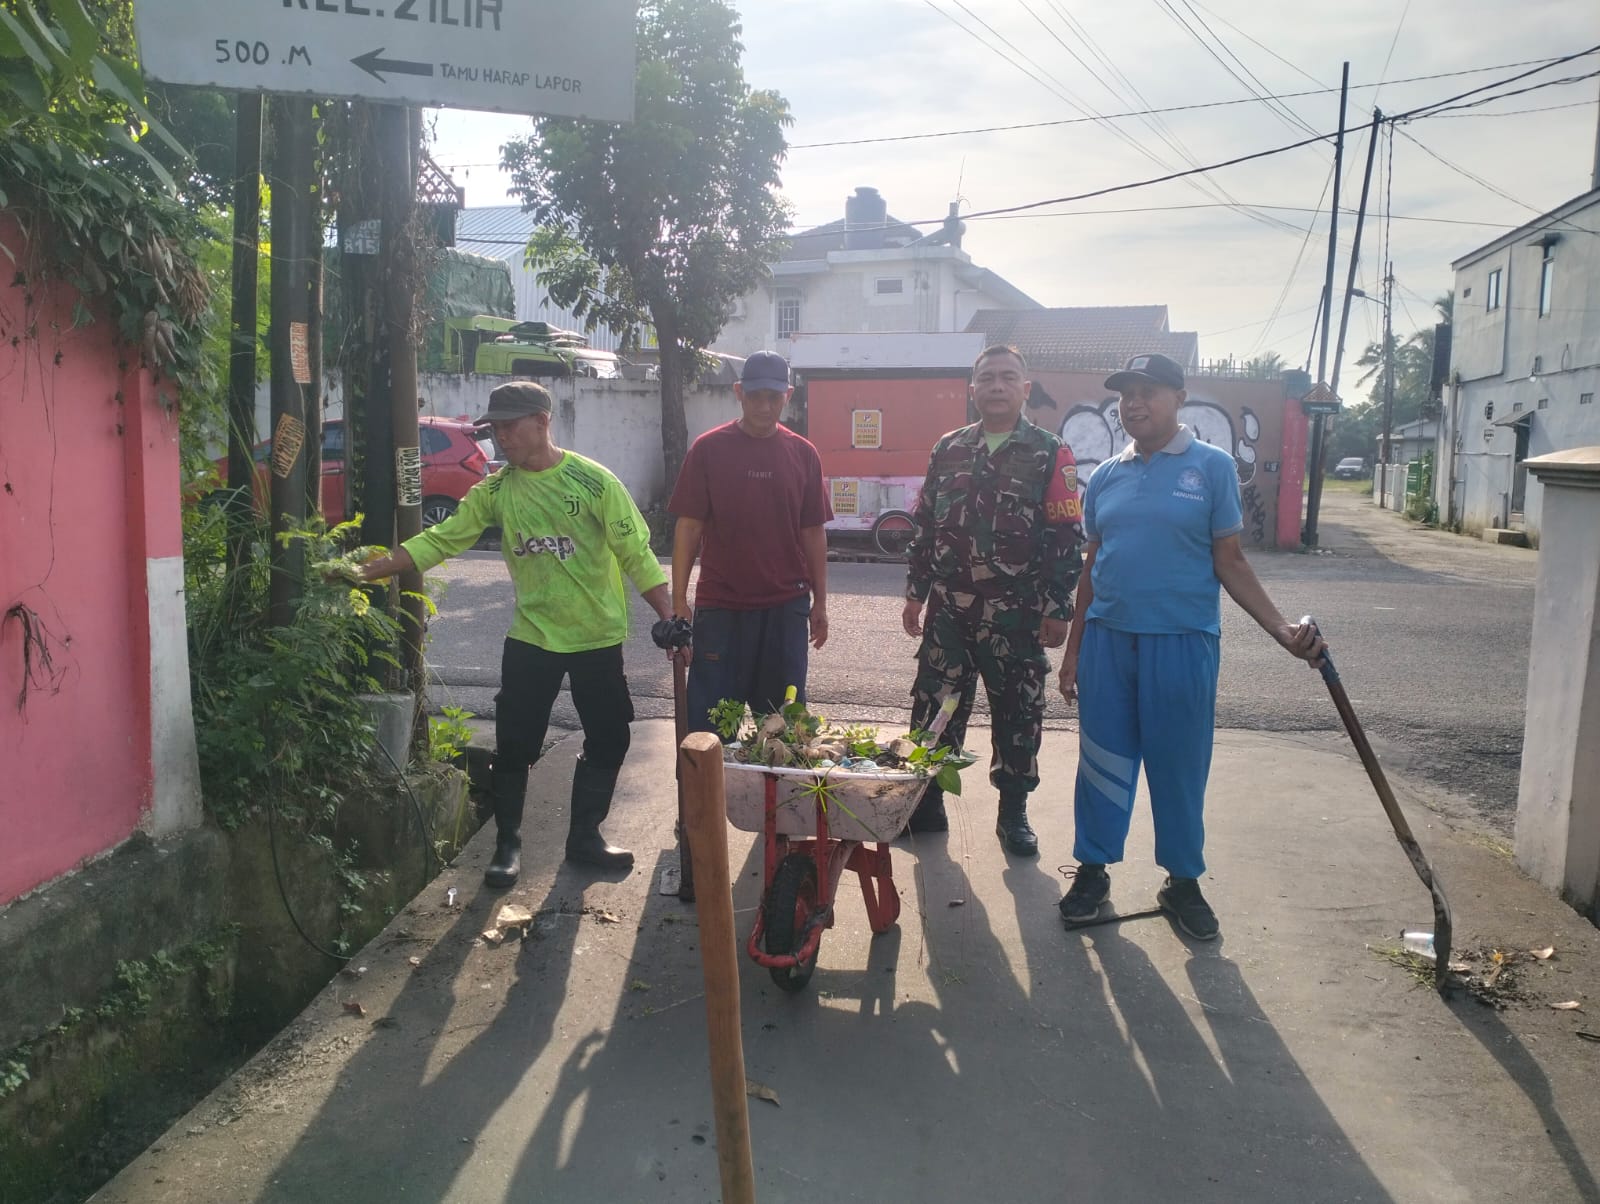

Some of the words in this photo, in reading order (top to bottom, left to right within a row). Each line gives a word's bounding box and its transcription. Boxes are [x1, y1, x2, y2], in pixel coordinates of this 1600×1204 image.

[216, 39, 270, 65] 500
[439, 62, 478, 81] TAMU
[483, 68, 530, 86] HARAP
[535, 73, 582, 93] LAPOR
[512, 532, 575, 560] Jeep
